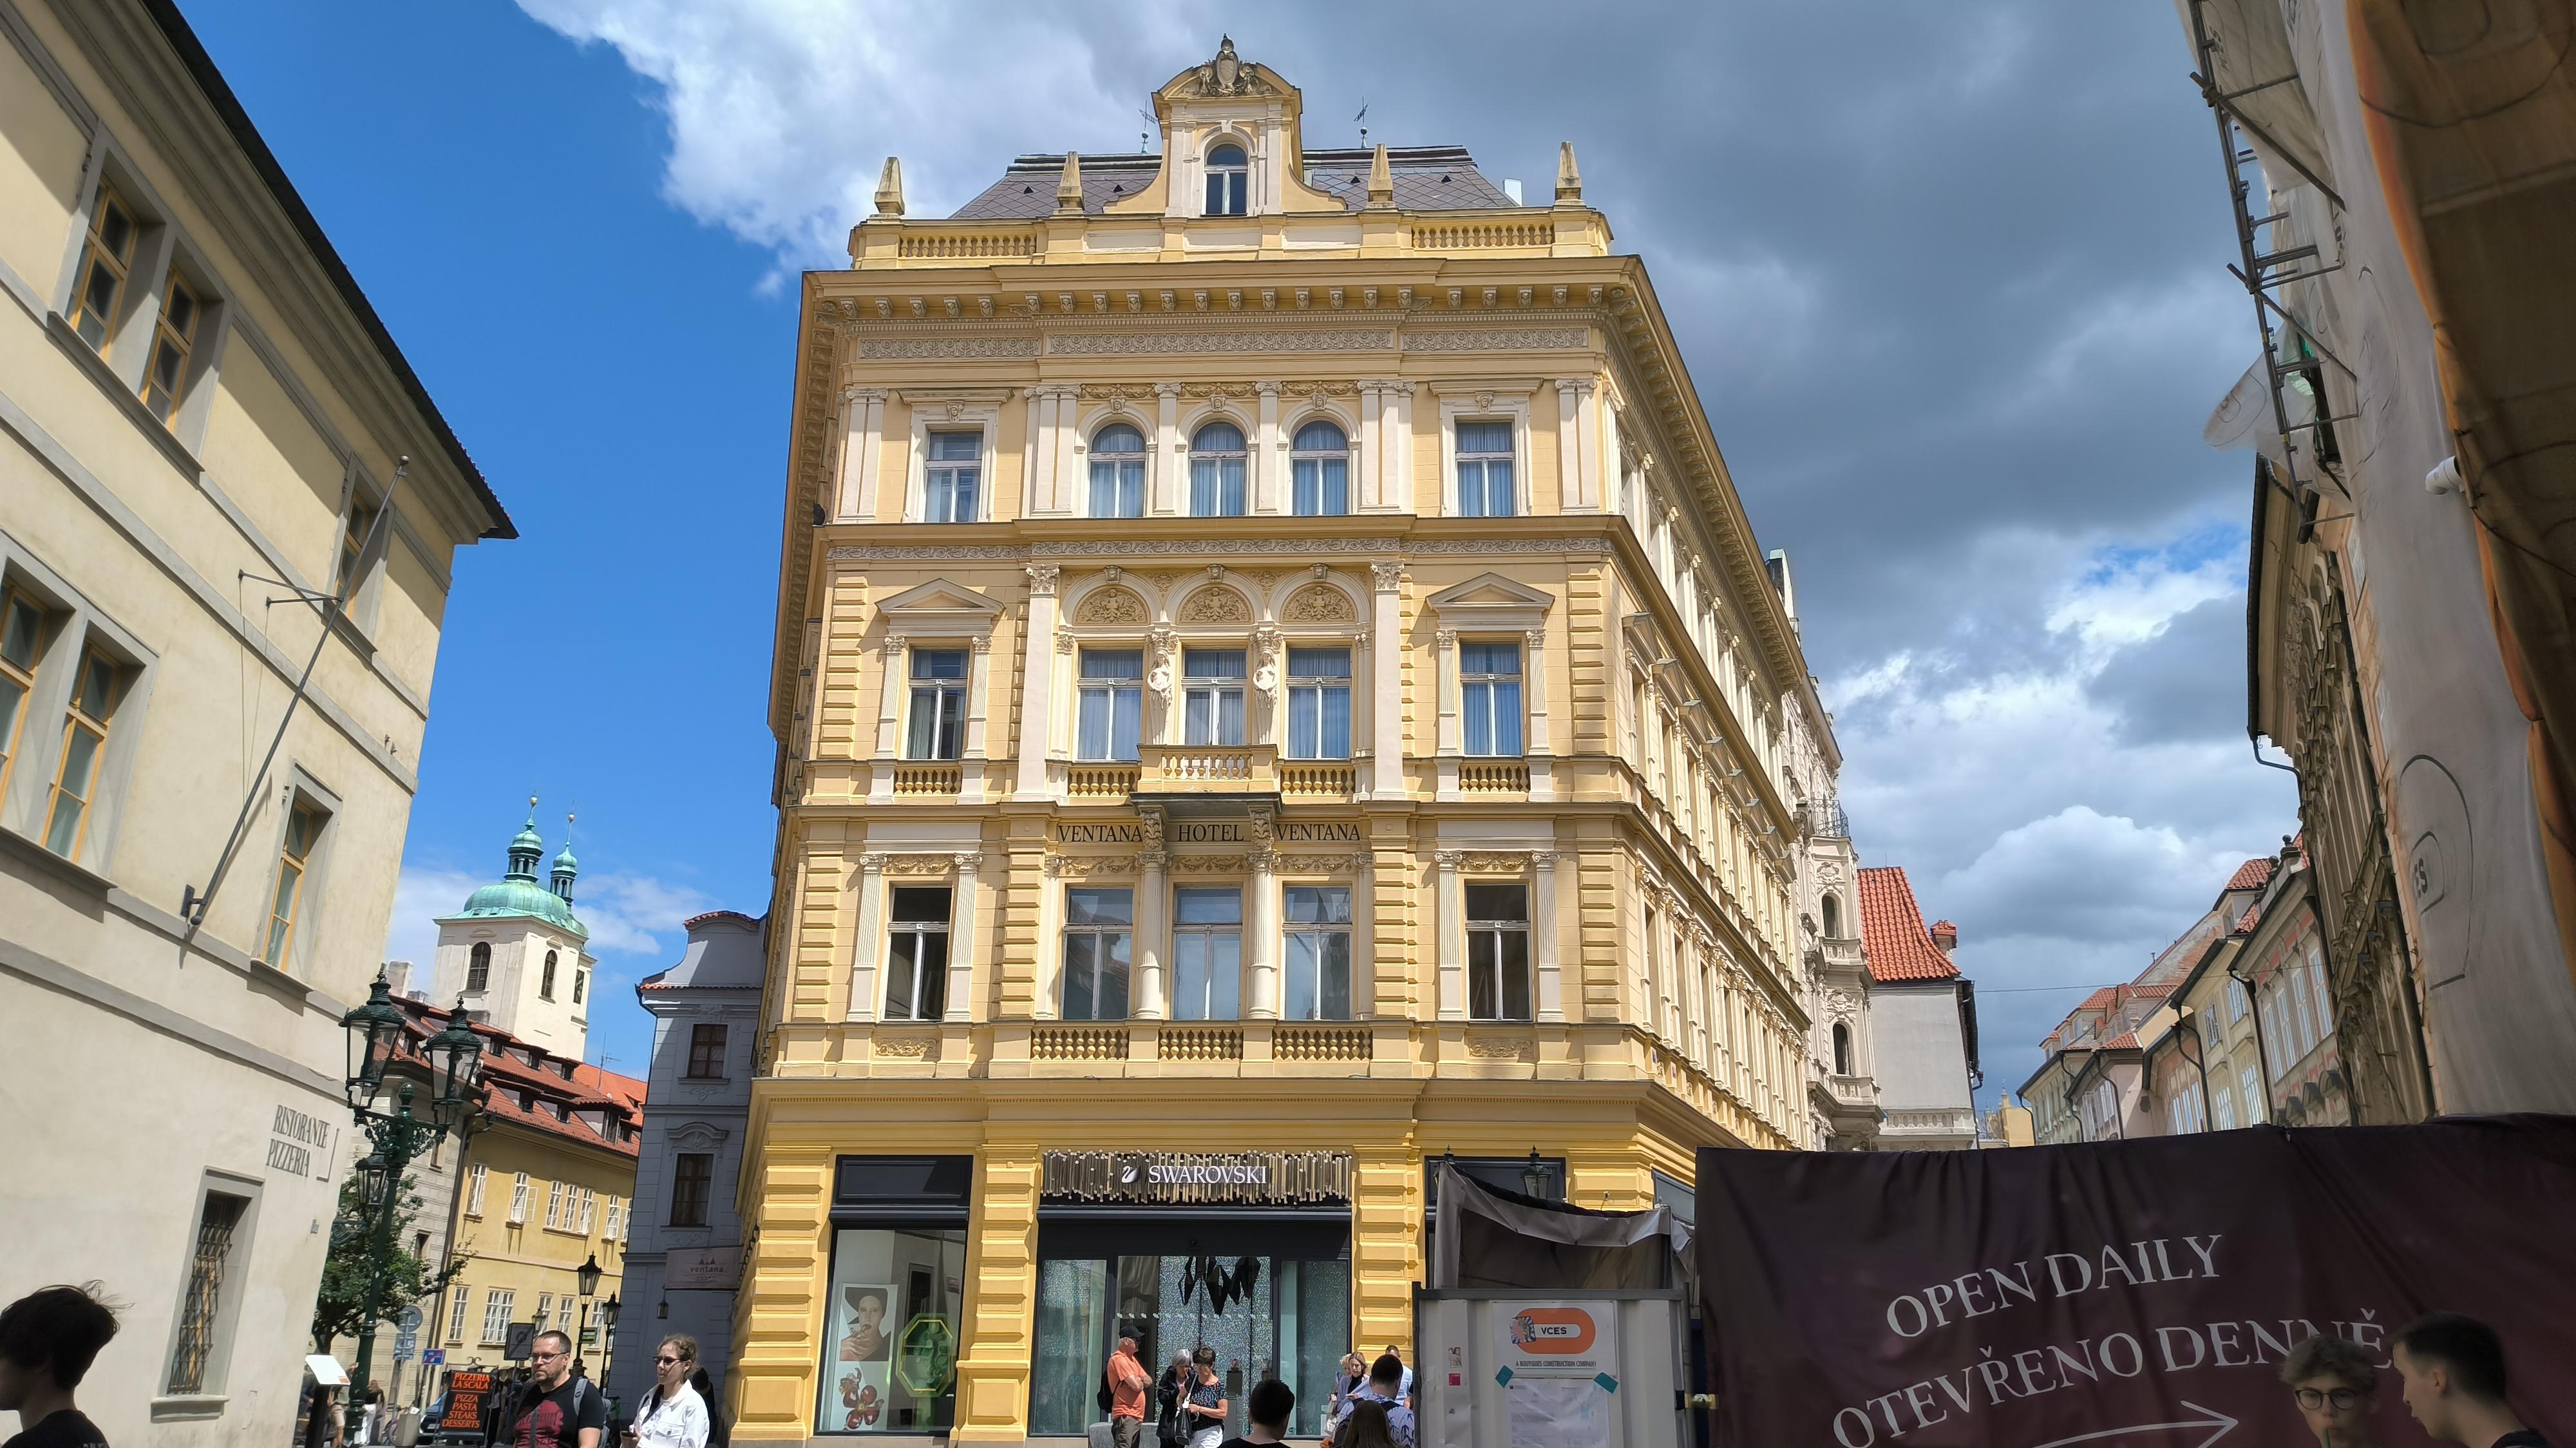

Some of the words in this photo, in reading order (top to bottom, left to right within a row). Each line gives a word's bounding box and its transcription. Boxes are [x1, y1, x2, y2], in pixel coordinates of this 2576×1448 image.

[1058, 824, 1143, 842] VENTANA
[1178, 824, 1244, 841] HOTEL
[1275, 823, 1360, 841] VENTANA
[273, 1104, 330, 1148] RISTORANTE
[266, 1138, 311, 1177] PIZZERIA
[1148, 1165, 1267, 1185] SWAROVSKI
[1887, 1261, 2036, 1338] OPEN
[2044, 1234, 2222, 1298] DAILY
[454, 1373, 489, 1382] PIZZERIA
[463, 1380, 488, 1389] SCALA
[1833, 1333, 2143, 1448] OTEVŘENO
[455, 1394, 478, 1402] PIZZA
[453, 1402, 477, 1411] PASTA
[448, 1411, 477, 1419] STEAKS
[442, 1419, 480, 1428] DESSERTS
